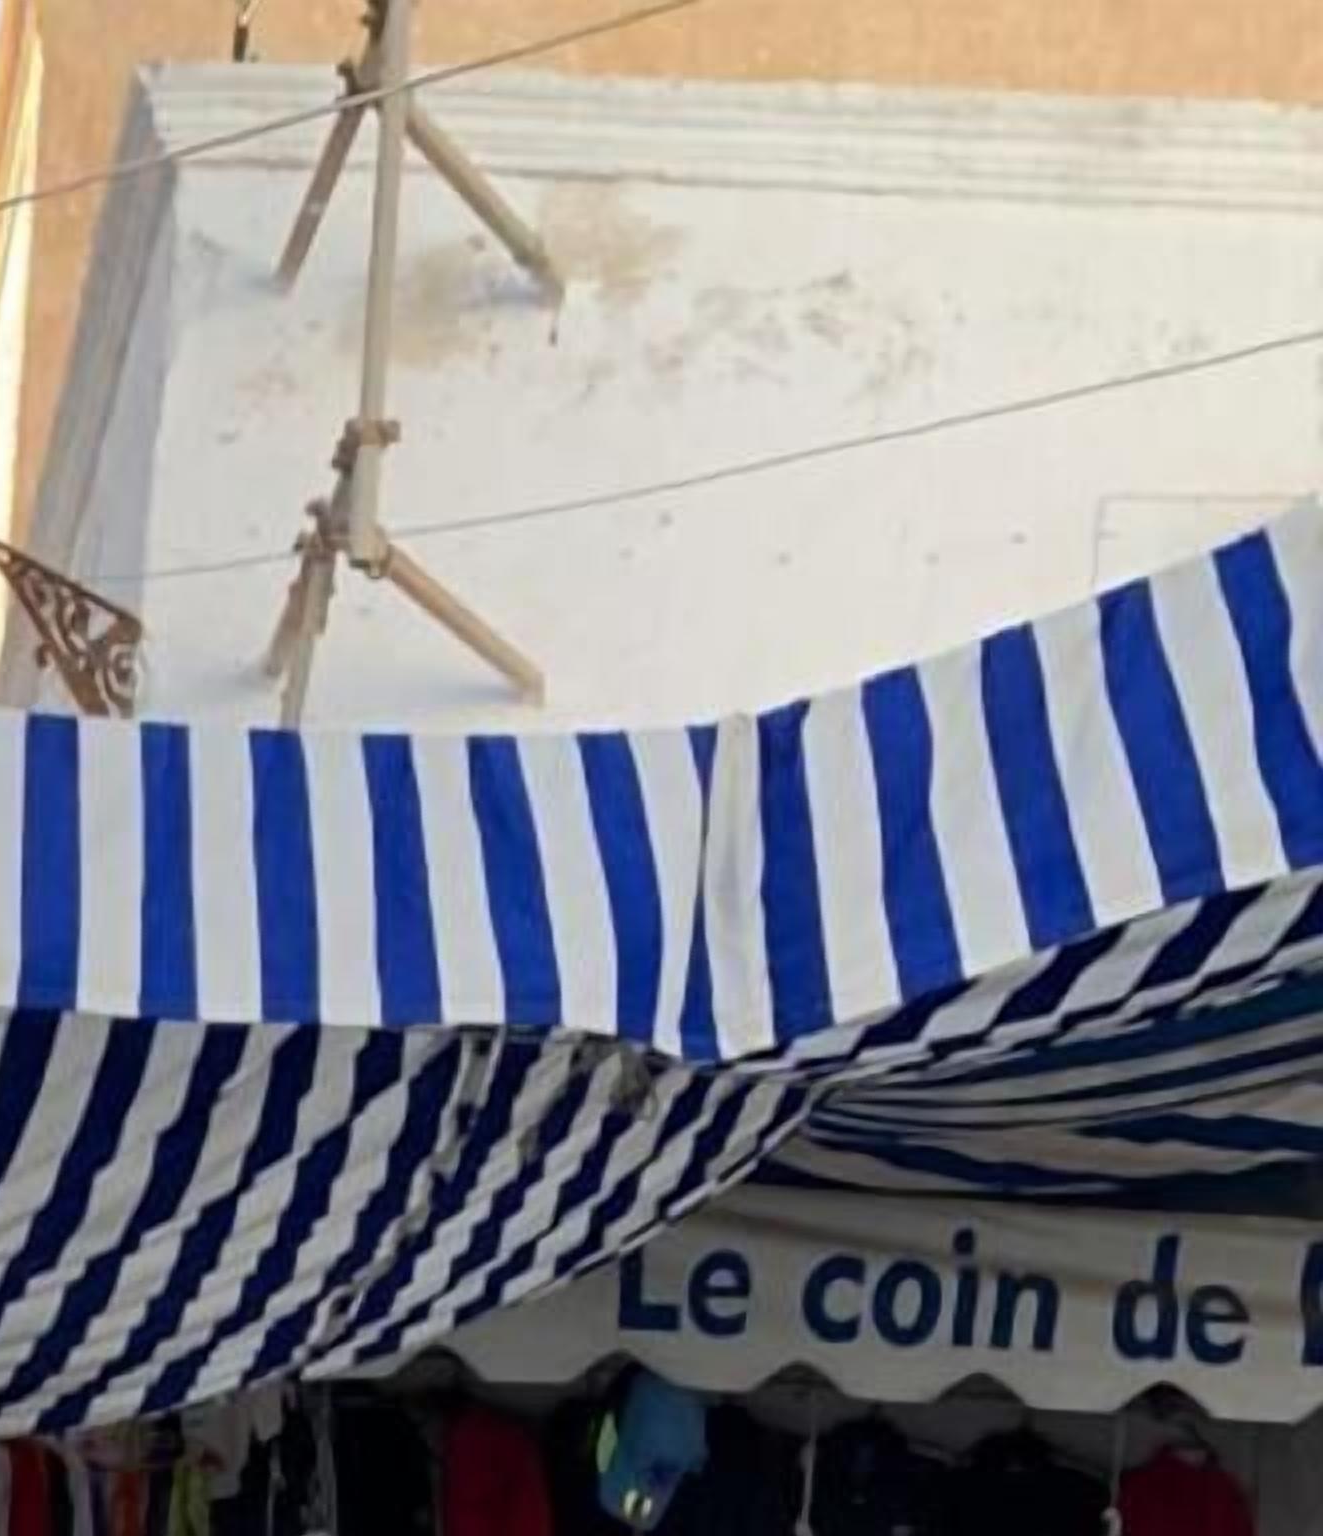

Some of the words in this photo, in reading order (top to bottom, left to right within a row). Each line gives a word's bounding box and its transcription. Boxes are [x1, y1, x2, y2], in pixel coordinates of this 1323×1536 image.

[617, 1247, 751, 1338] Le
[801, 1227, 1061, 1353] coin
[1111, 1233, 1251, 1365] de
